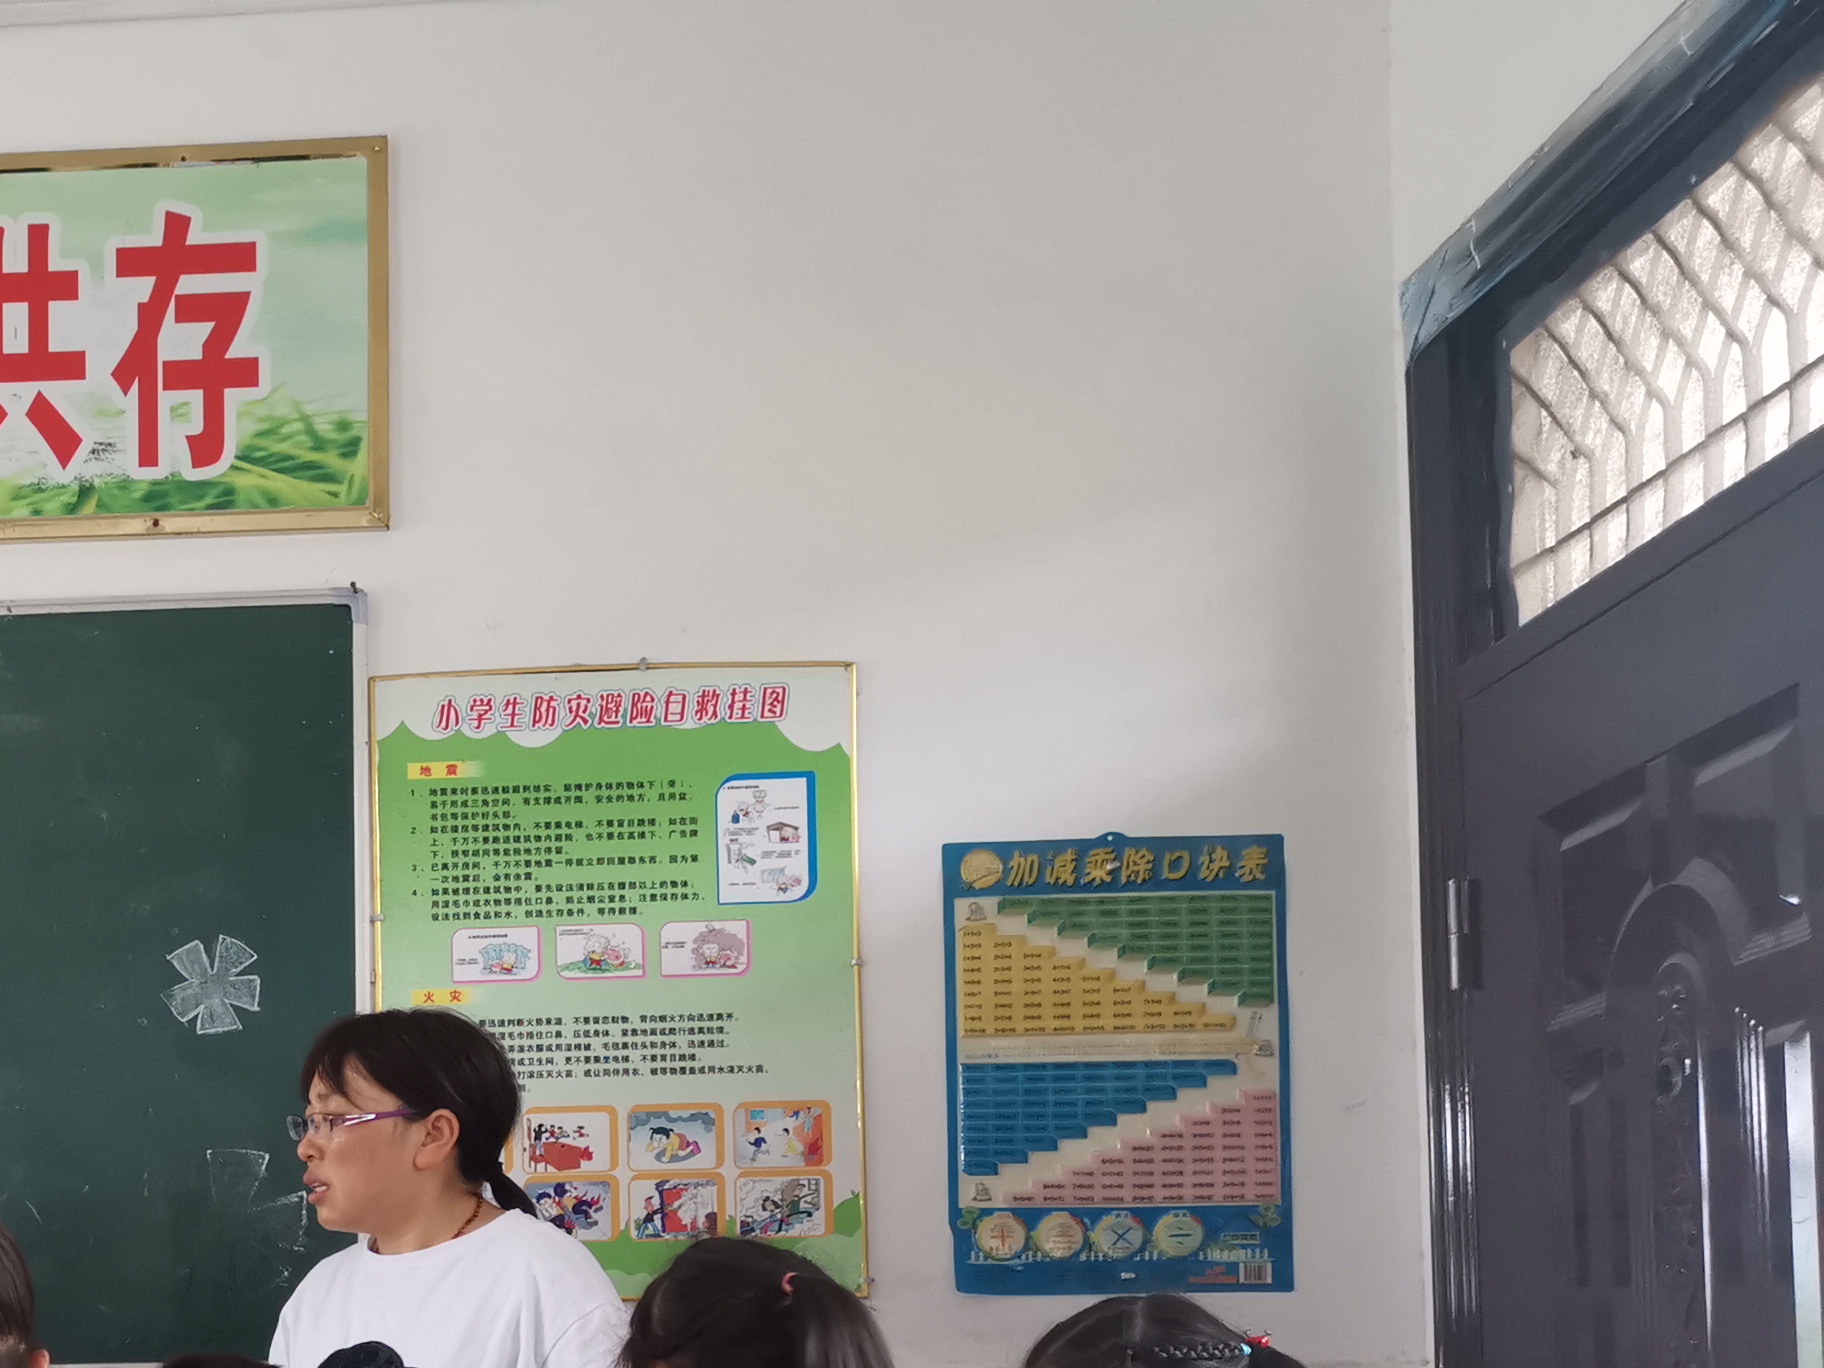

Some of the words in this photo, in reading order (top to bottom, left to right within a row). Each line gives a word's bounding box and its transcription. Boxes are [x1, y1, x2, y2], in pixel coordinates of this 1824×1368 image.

[434, 684, 789, 732] 小学生防灾避险自救挂图
[420, 764, 458, 777] 地震
[1006, 846, 1268, 888] 加减乘除口诀表
[424, 990, 462, 1003] 火灾
